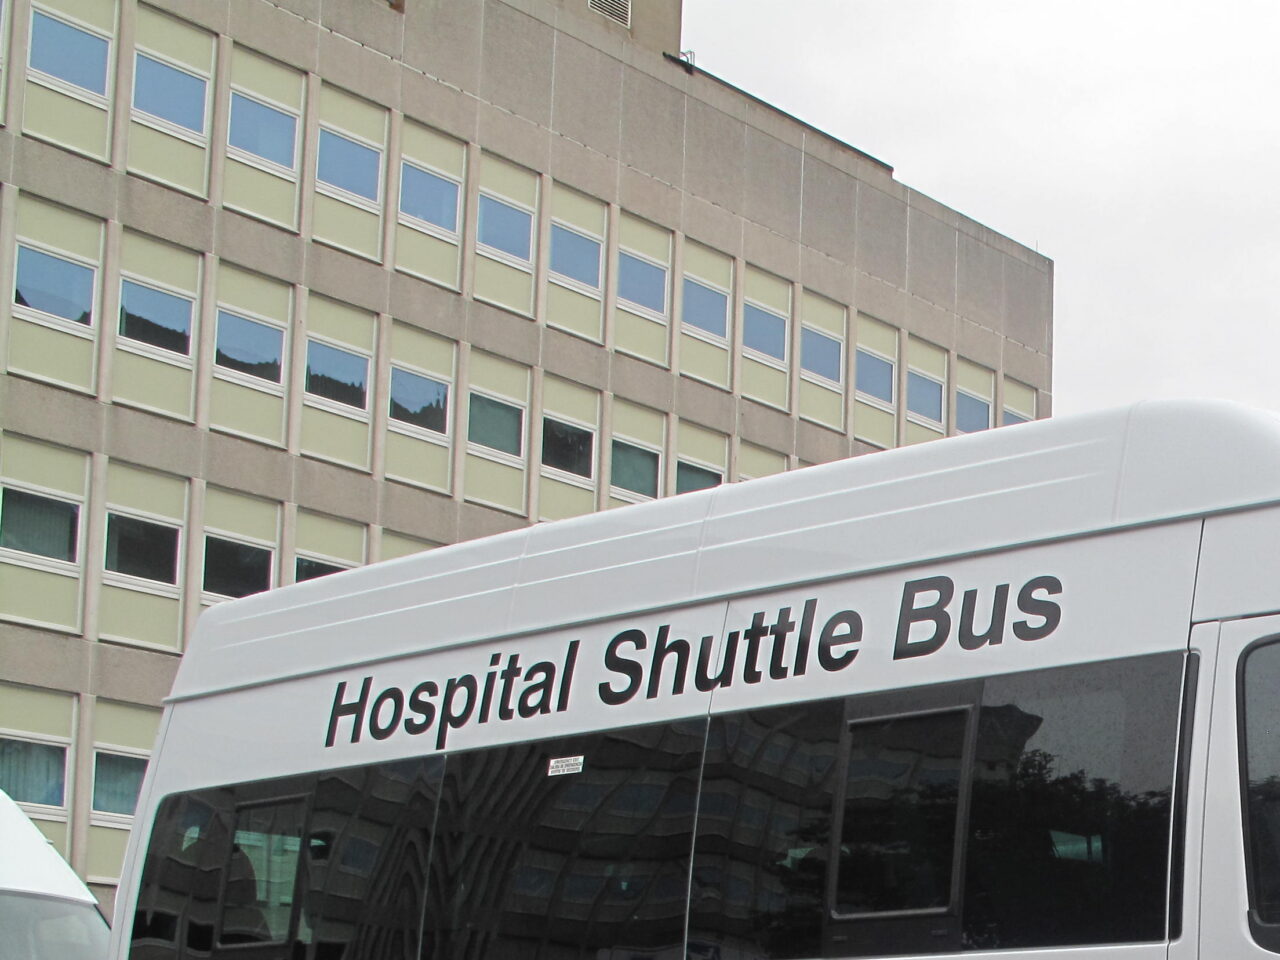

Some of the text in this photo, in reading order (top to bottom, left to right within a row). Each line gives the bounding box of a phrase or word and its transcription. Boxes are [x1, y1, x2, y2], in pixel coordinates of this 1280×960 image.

[325, 574, 1064, 749] Hospital Shuttle Bus
